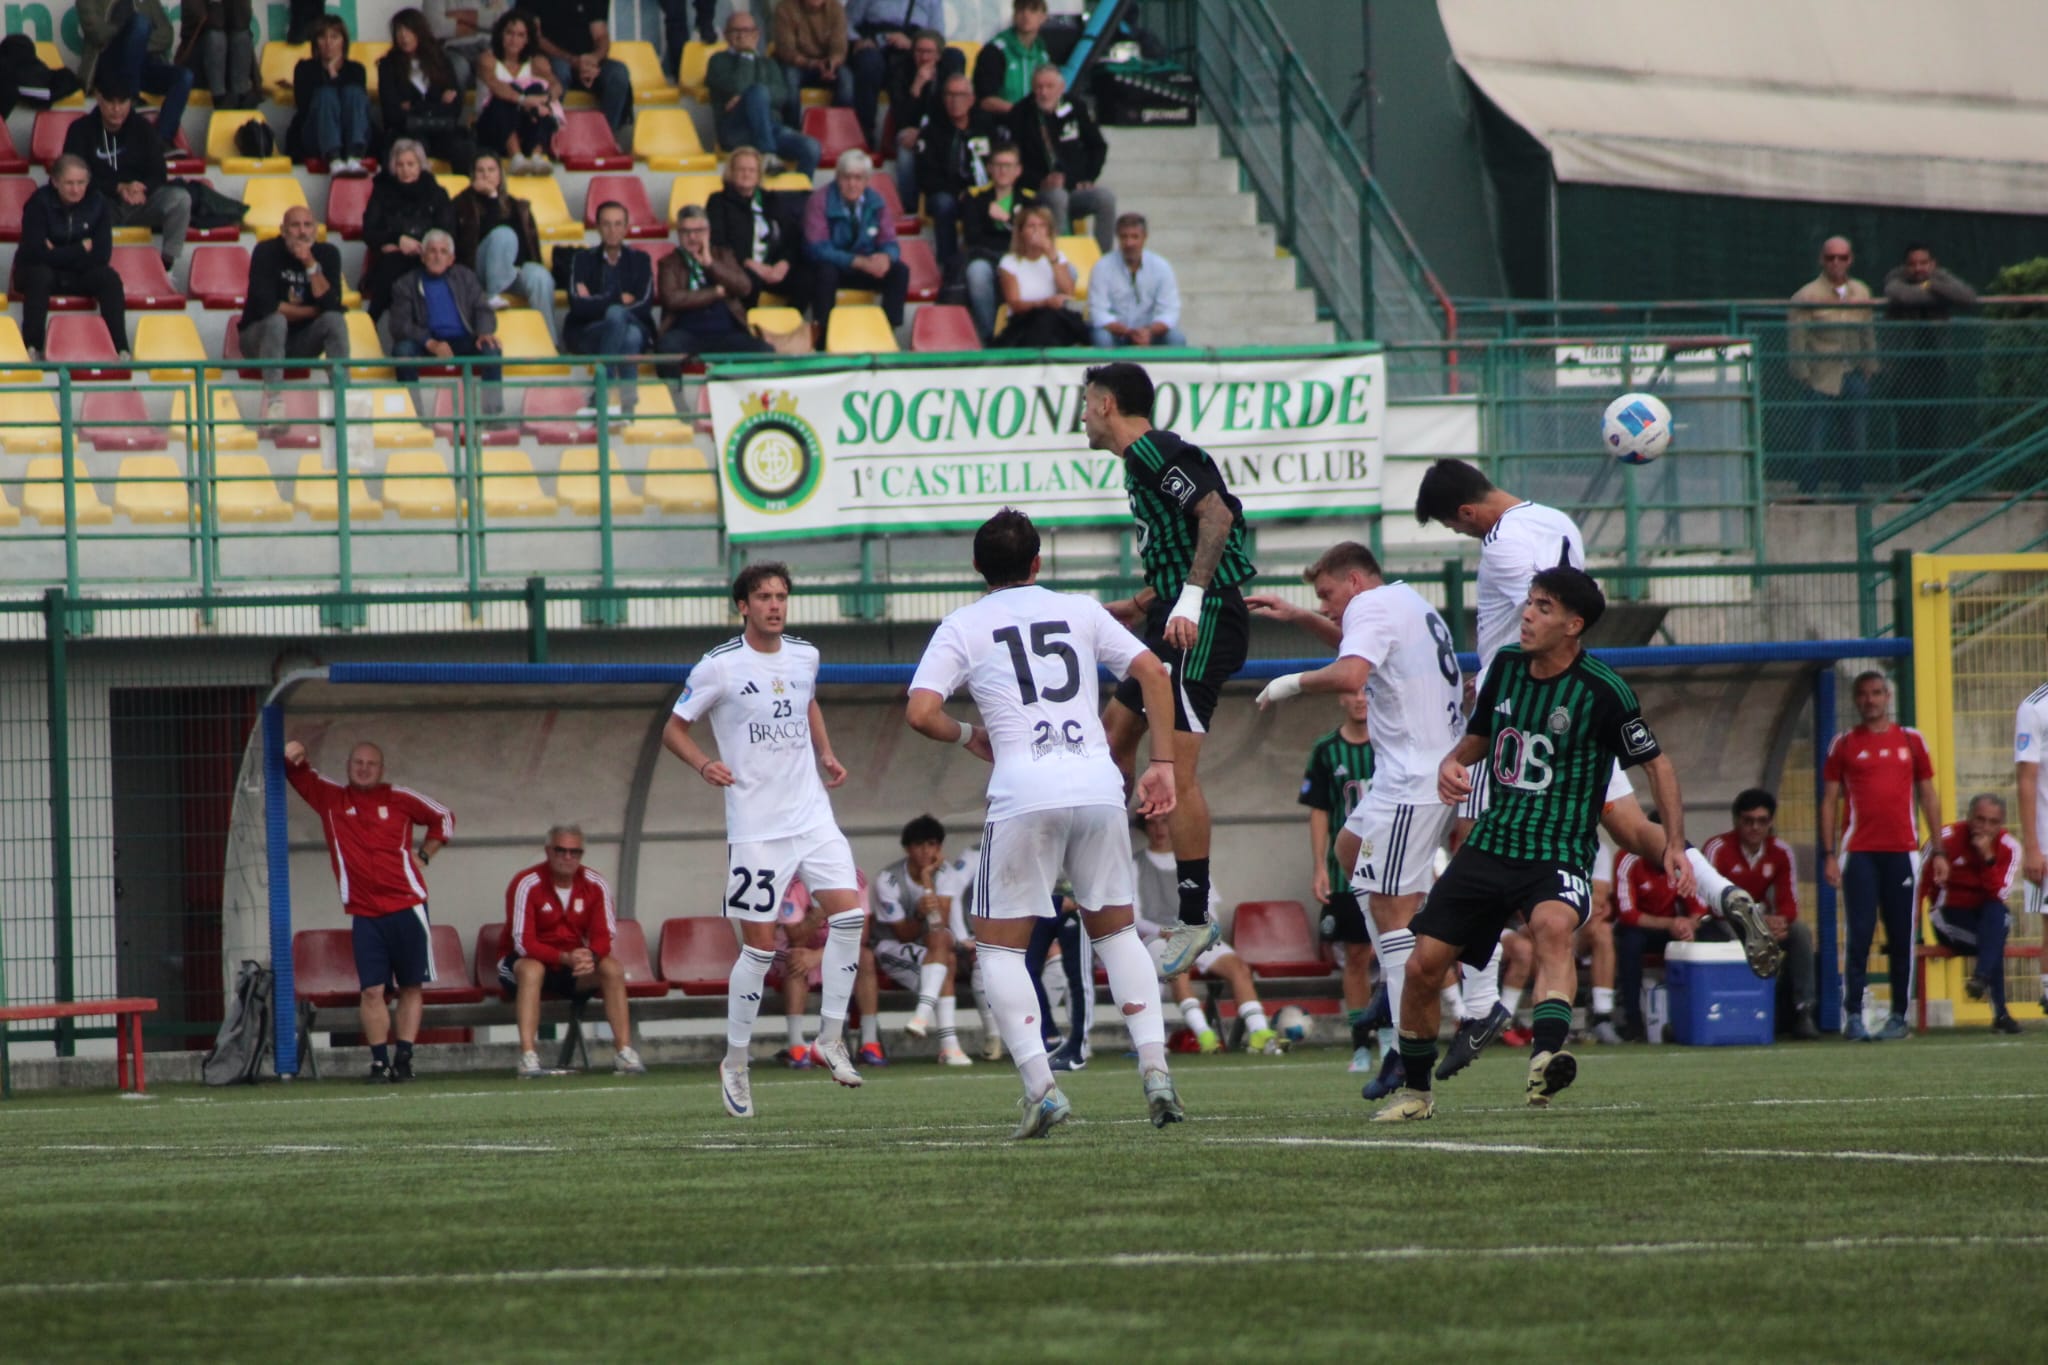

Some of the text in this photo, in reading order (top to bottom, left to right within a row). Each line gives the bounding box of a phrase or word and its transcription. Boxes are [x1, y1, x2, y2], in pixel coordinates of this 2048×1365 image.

[1220, 453, 1264, 487] AN
[1272, 448, 1368, 485] CLUB
[992, 620, 1081, 706] 15
[1425, 612, 1460, 687] 8
[773, 699, 792, 719] 23
[728, 866, 776, 913] 23
[1557, 869, 1586, 897] 10
